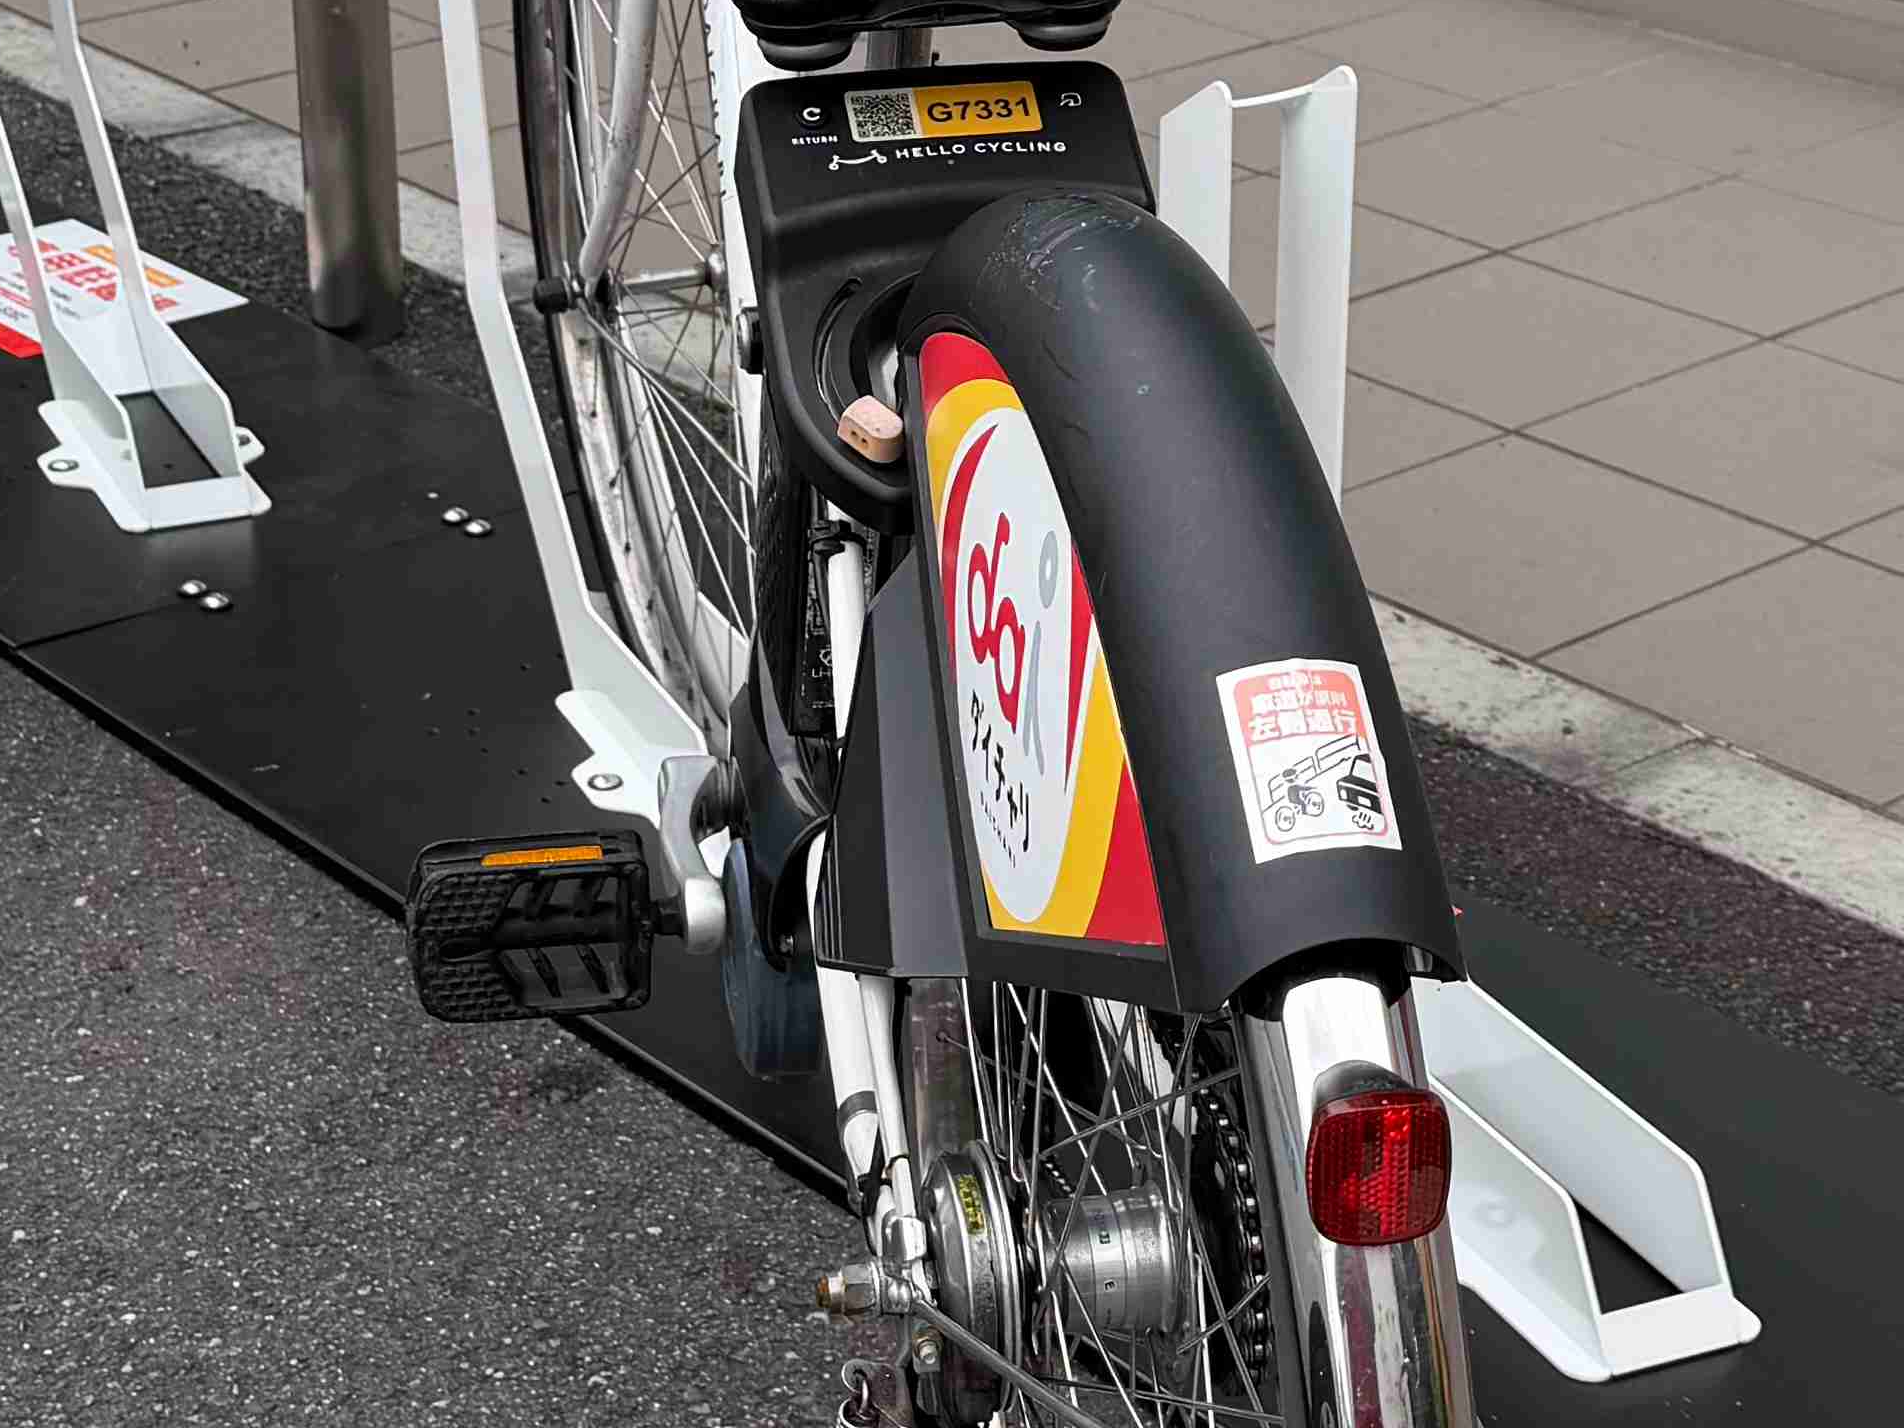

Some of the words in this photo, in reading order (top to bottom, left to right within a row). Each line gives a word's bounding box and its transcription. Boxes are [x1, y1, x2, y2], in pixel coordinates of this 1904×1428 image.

[926, 96, 1032, 123] G7331
[790, 134, 839, 148] RETURN
[895, 143, 966, 160] HELLO
[973, 140, 1068, 155] CYCLING
[1247, 708, 1358, 742] 左側通行
[970, 688, 1031, 853] ダイチャリ
